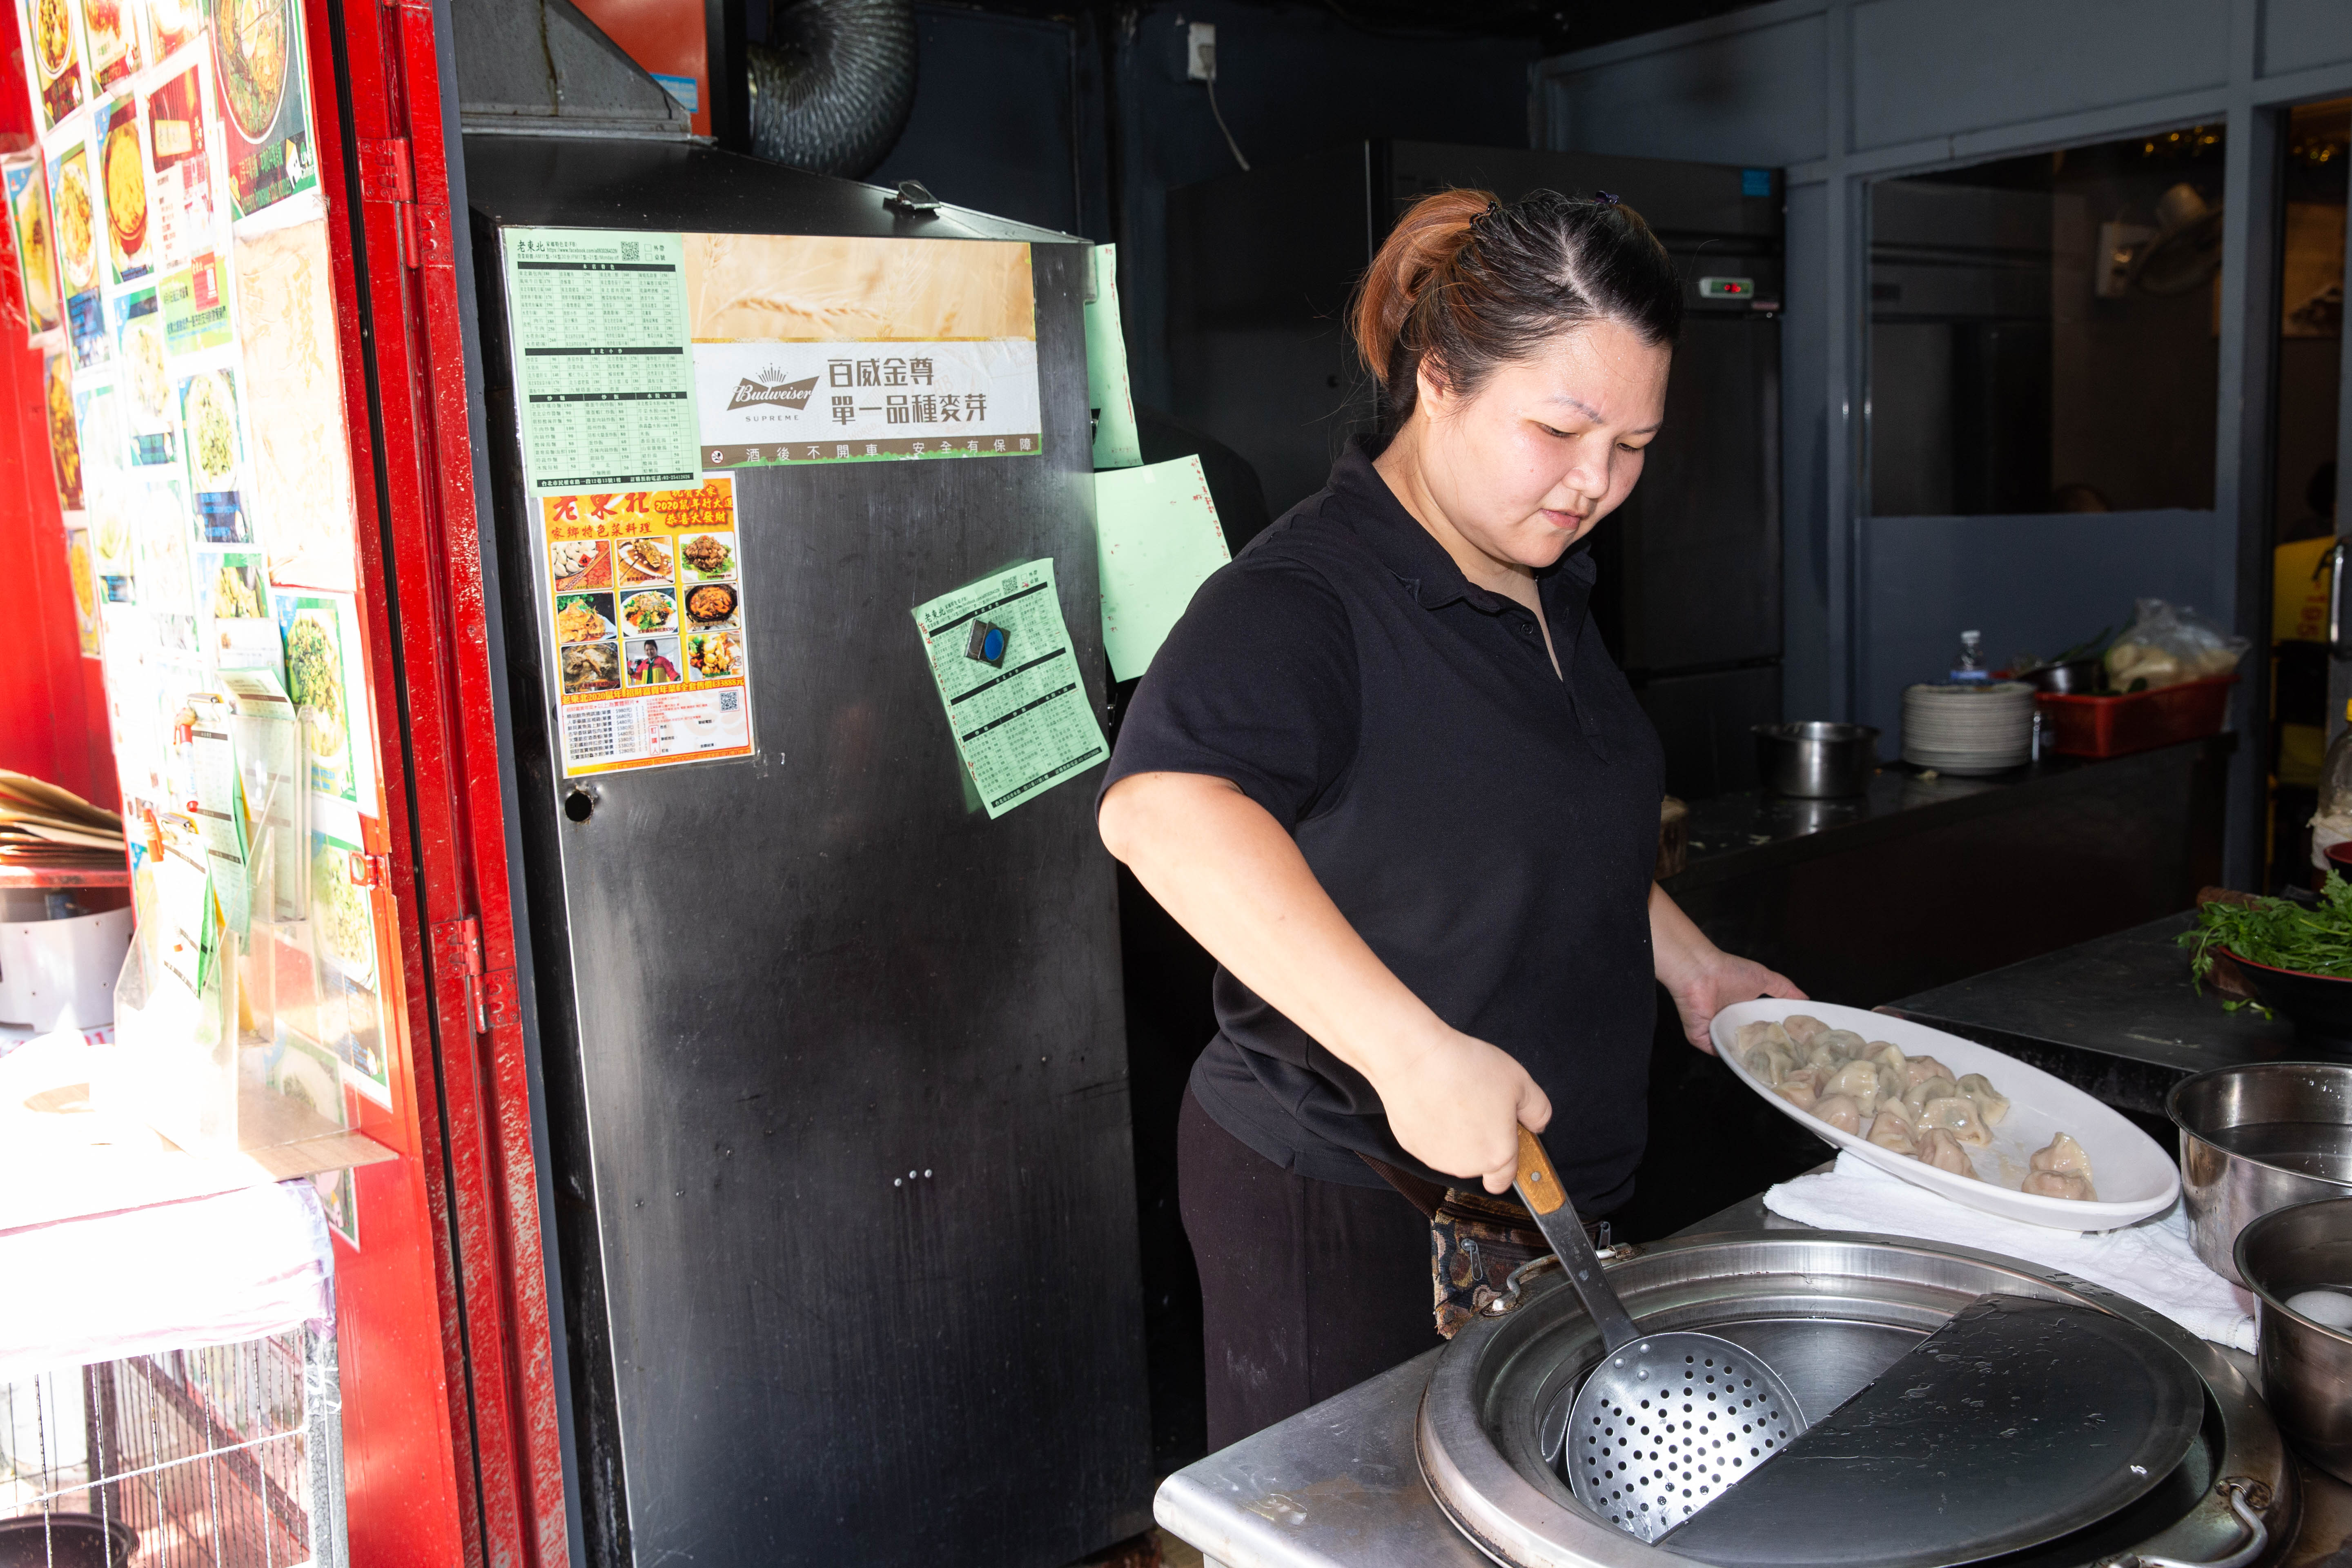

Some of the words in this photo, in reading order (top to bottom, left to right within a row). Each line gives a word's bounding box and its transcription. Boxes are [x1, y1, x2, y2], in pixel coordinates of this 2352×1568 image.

[517, 240, 545, 252] 老東北
[827, 358, 934, 388] 百威金尊
[733, 382, 812, 403] Budweiser
[832, 394, 987, 425] 單一品種麥芽
[746, 444, 878, 462] 酒後不開車
[913, 438, 1032, 455] 安全有保障
[553, 492, 649, 522] 老東北
[655, 497, 733, 510] 2020鼠年行大運
[666, 512, 726, 525] 恭喜大發財
[551, 522, 652, 539] 家鄉特色菜料理
[924, 607, 945, 623] 老東北
